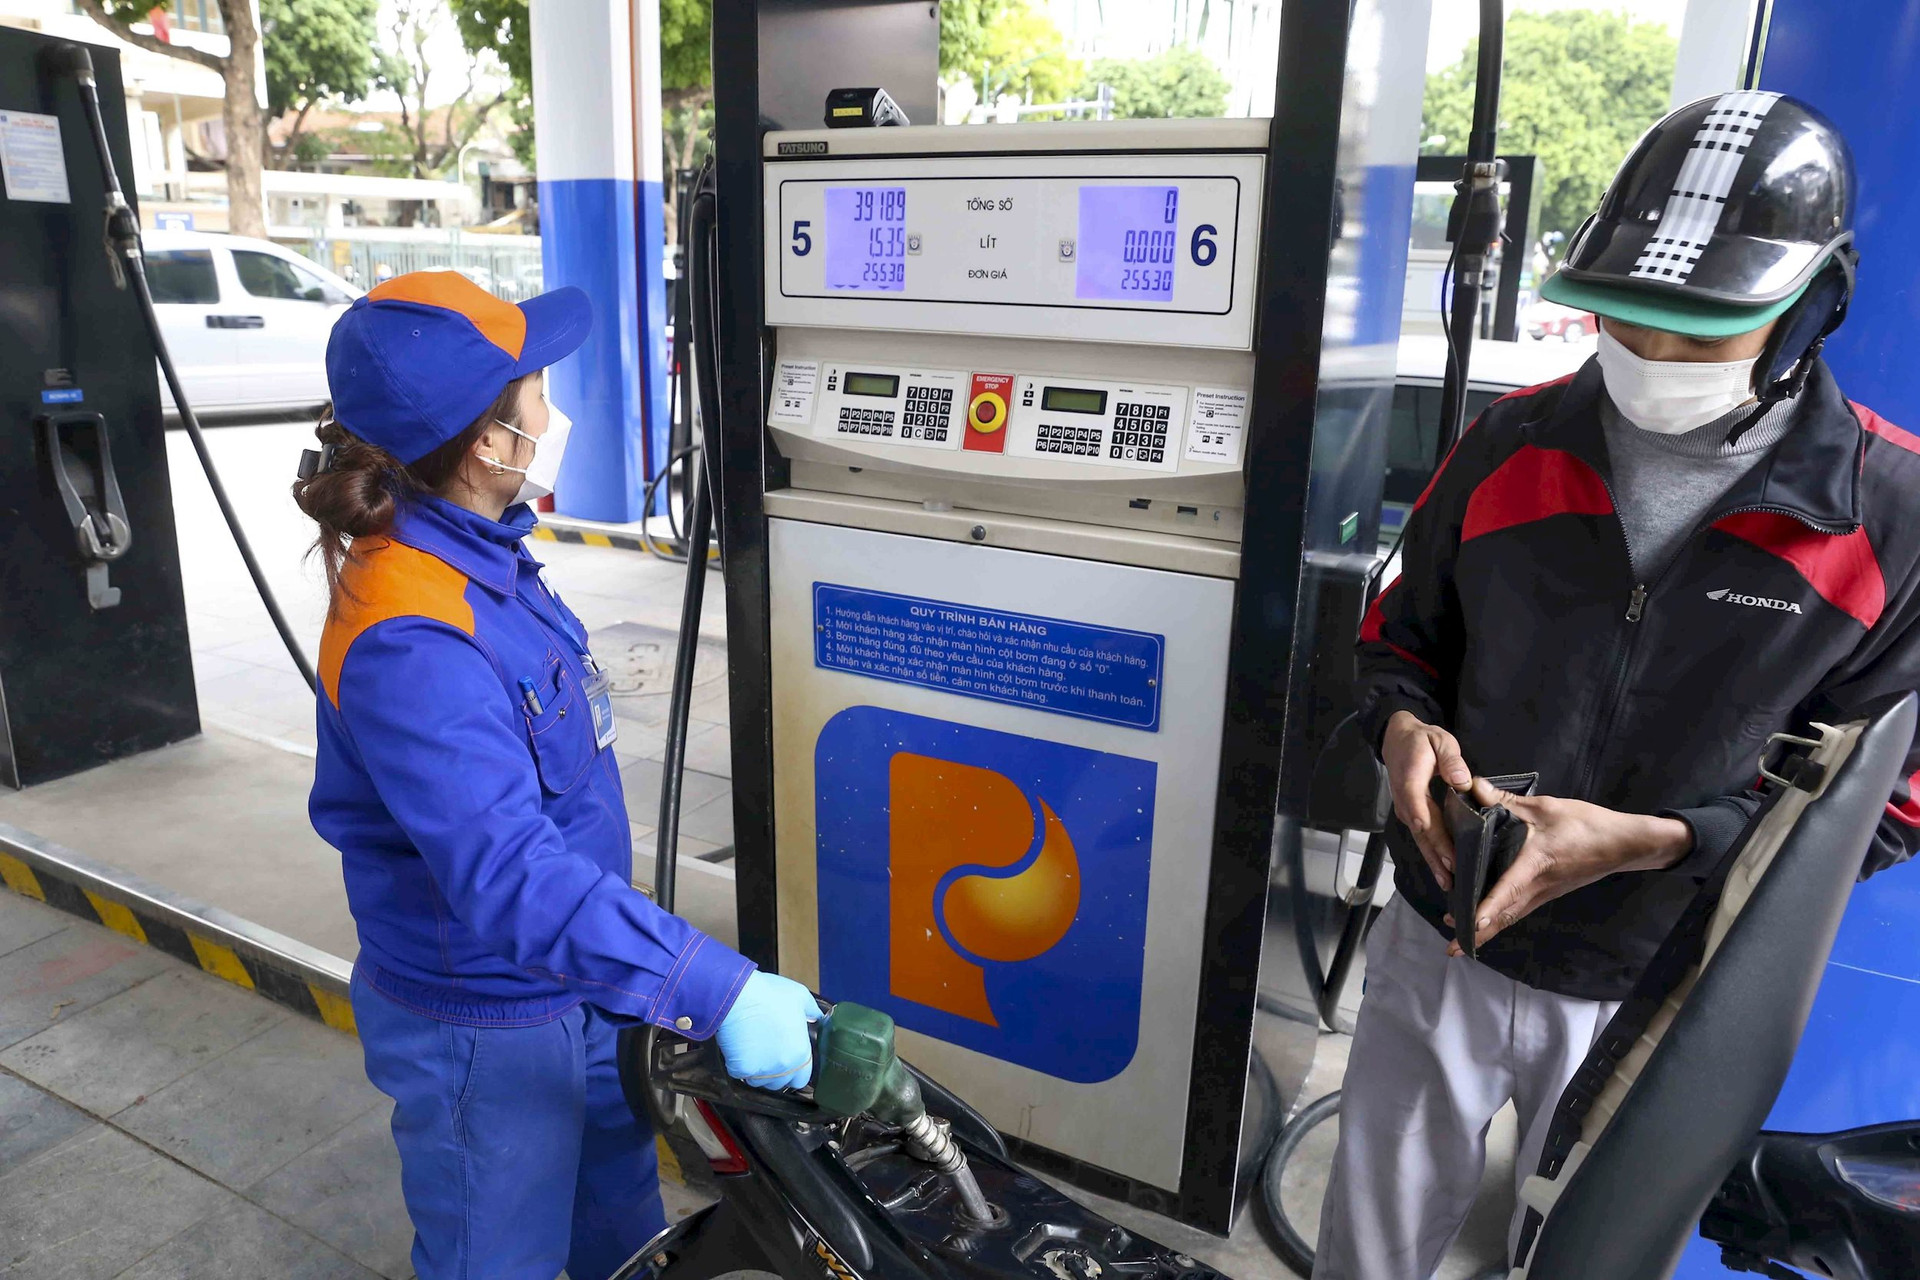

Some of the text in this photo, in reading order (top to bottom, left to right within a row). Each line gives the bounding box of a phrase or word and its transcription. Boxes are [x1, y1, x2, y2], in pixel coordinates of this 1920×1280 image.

[779, 142, 826, 154] TATSUNO
[853, 190, 906, 221] 39189
[998, 196, 1014, 211] SỐ
[1164, 189, 1178, 224] 0
[791, 220, 812, 257] 5
[979, 233, 998, 249] LÍT
[1190, 223, 1218, 267] 6
[862, 262, 905, 282] 25530
[968, 267, 1008, 280] ĐƠN GIÁ
[1121, 268, 1173, 291] 25530
[909, 387, 916, 397] 7
[920, 388, 927, 398] 8
[932, 389, 939, 399] 9
[1196, 391, 1246, 401] Preset Instruction
[907, 401, 914, 411] 4
[918, 402, 925, 412] 5
[930, 403, 937, 412] 6
[1119, 404, 1168, 417] 7 8 9 F1
[916, 415, 923, 425] 2
[928, 416, 935, 426] 3
[1116, 418, 1166, 432] 4 5 6 F2
[903, 427, 910, 437] 0
[914, 428, 922, 438] C
[1039, 426, 1101, 440] P1 P2 P3 P4 P5
[1127, 434, 1136, 444] 2
[1141, 435, 1149, 446] 3
[1154, 437, 1164, 446] F3
[1036, 440, 1100, 455] P6 P7 P8 P9 P10
[1112, 447, 1162, 460] 0 C F4
[1725, 593, 1803, 615] HONDA
[910, 606, 936, 618] QUY
[938, 610, 976, 625] TRÌNH
[877, 613, 900, 626] khách
[921, 621, 936, 632] vào
[992, 634, 1003, 643] và
[1005, 635, 1019, 646] xác
[1021, 638, 1041, 650] nhận
[1043, 642, 1059, 652] nhu
[1078, 647, 1094, 658] của
[1096, 649, 1122, 663] khách
[836, 631, 857, 643] Bơm
[924, 647, 944, 659] theo
[986, 658, 1004, 669] của
[1006, 661, 1036, 675] khách
[854, 623, 881, 635] khách
[908, 632, 924, 643] xác
[926, 636, 949, 648] nhận
[1016, 650, 1039, 663] bơm
[1041, 655, 1066, 670] đang
[1080, 660, 1092, 672] số
[836, 654, 859, 667] Nhận
[874, 661, 890, 672] xác
[892, 665, 914, 677] nhận
[989, 683, 1019, 697] khách
[855, 647, 881, 660] khách
[908, 656, 924, 667] xác
[926, 660, 949, 672] nhận
[1015, 675, 1038, 688] bơm
[1070, 685, 1085, 696] khi
[1088, 688, 1117, 702] thanh
